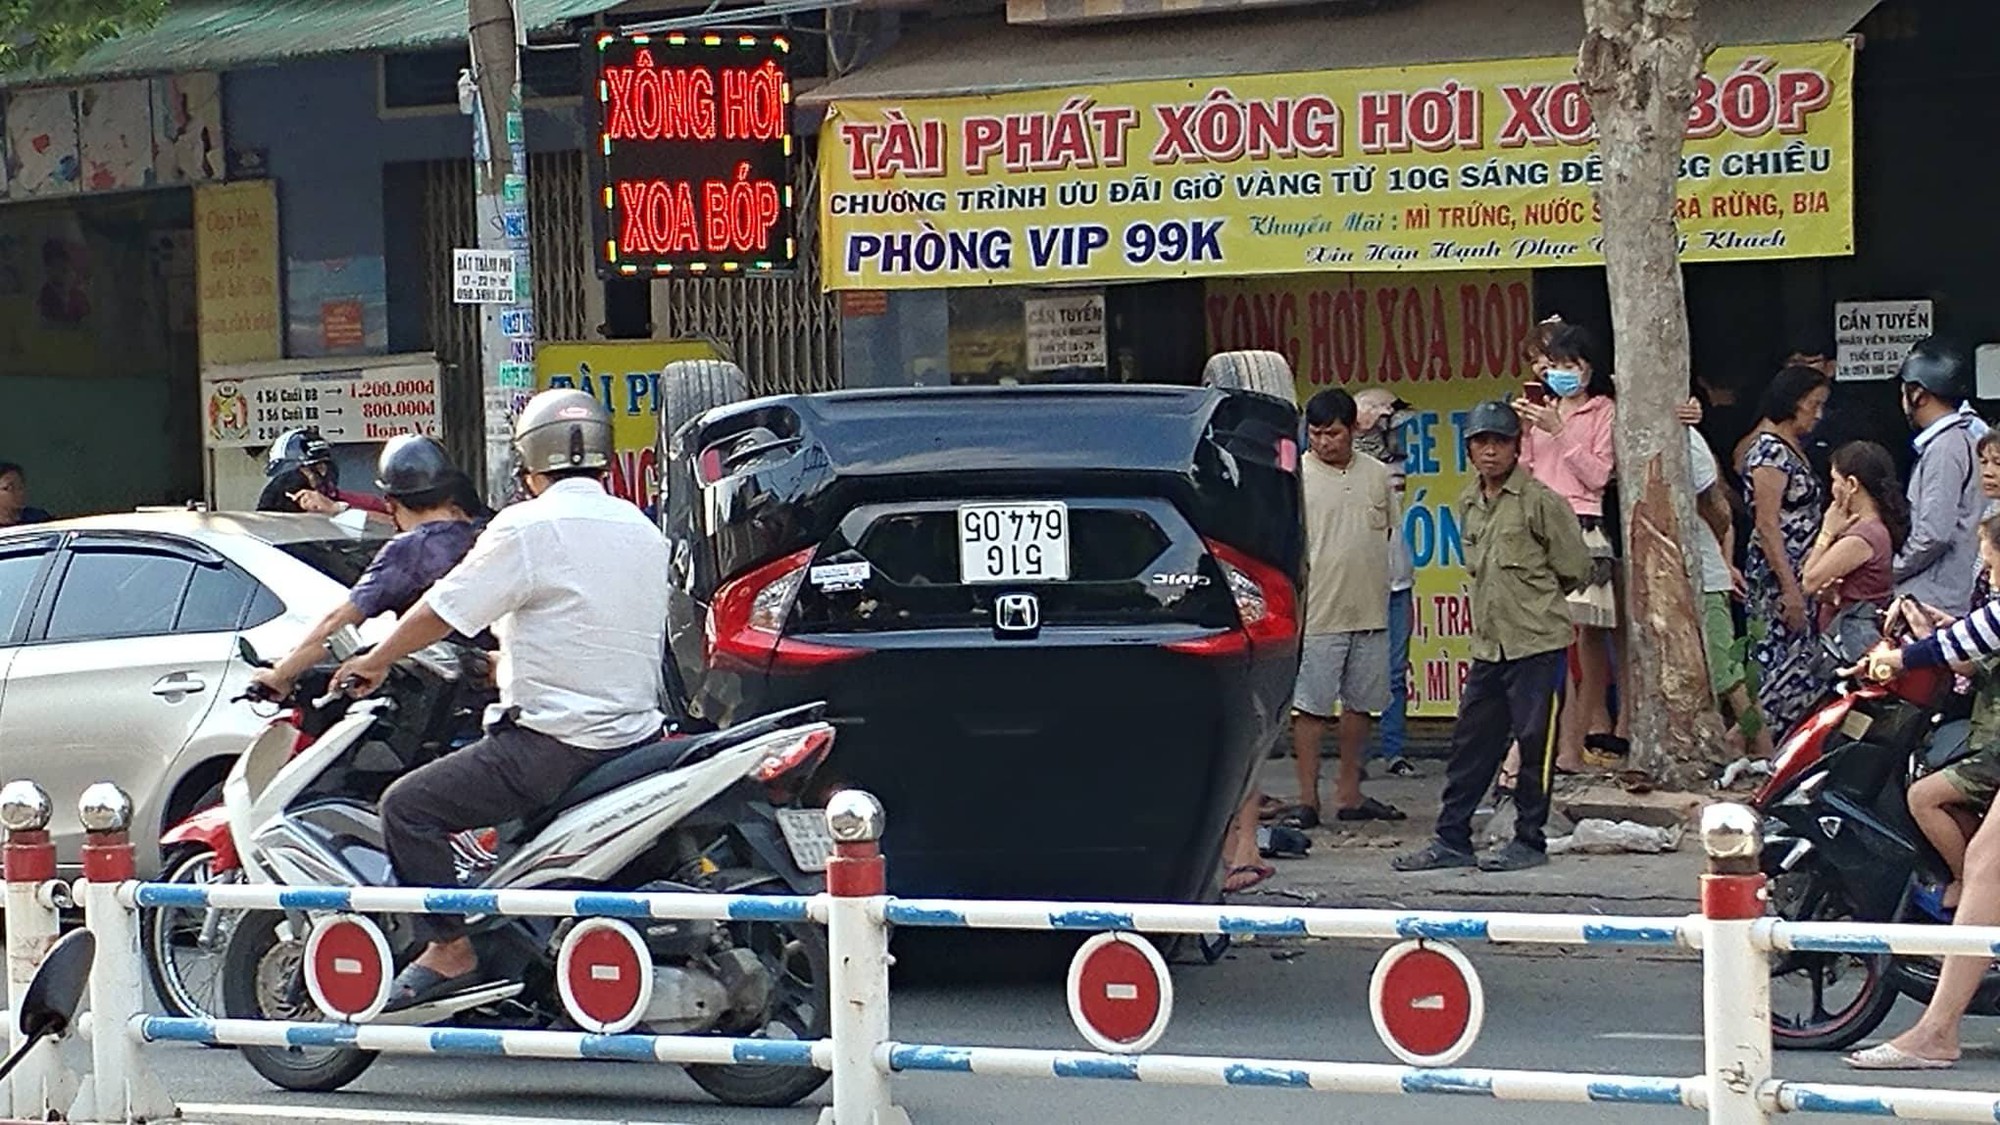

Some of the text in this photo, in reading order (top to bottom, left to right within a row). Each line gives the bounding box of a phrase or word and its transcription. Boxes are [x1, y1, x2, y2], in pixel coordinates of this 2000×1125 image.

[606, 48, 785, 140] XÔNG HƠI
[842, 108, 947, 180] TÀI
[963, 98, 1140, 176] PHÁT
[1152, 87, 1345, 165] XÔNG
[1359, 79, 1484, 155] HƠI
[1499, 80, 1599, 149] XO
[619, 160, 779, 254] XOA BÓP
[830, 189, 946, 214] CHƯƠNG
[956, 183, 1046, 211] TRÌNH
[1059, 180, 1098, 206] ƯU
[1109, 174, 1161, 203] ĐÃI
[1235, 169, 1322, 198] VÀNG
[1331, 165, 1376, 194] TỪ
[1389, 167, 1449, 191] 10G
[1461, 159, 1549, 188] SÁNG
[1721, 141, 1831, 178] CHIỀU
[1405, 203, 1431, 231] MÌ
[1524, 196, 1585, 227] NƯỚC
[1793, 190, 1830, 215] BIA
[847, 220, 1225, 273] PHÒNG VIP 99K
[1376, 281, 1452, 382] XOA
[964, 508, 1062, 543] 644.05
[986, 543, 1042, 576] 51G
[1425, 650, 1451, 701] MÌ
